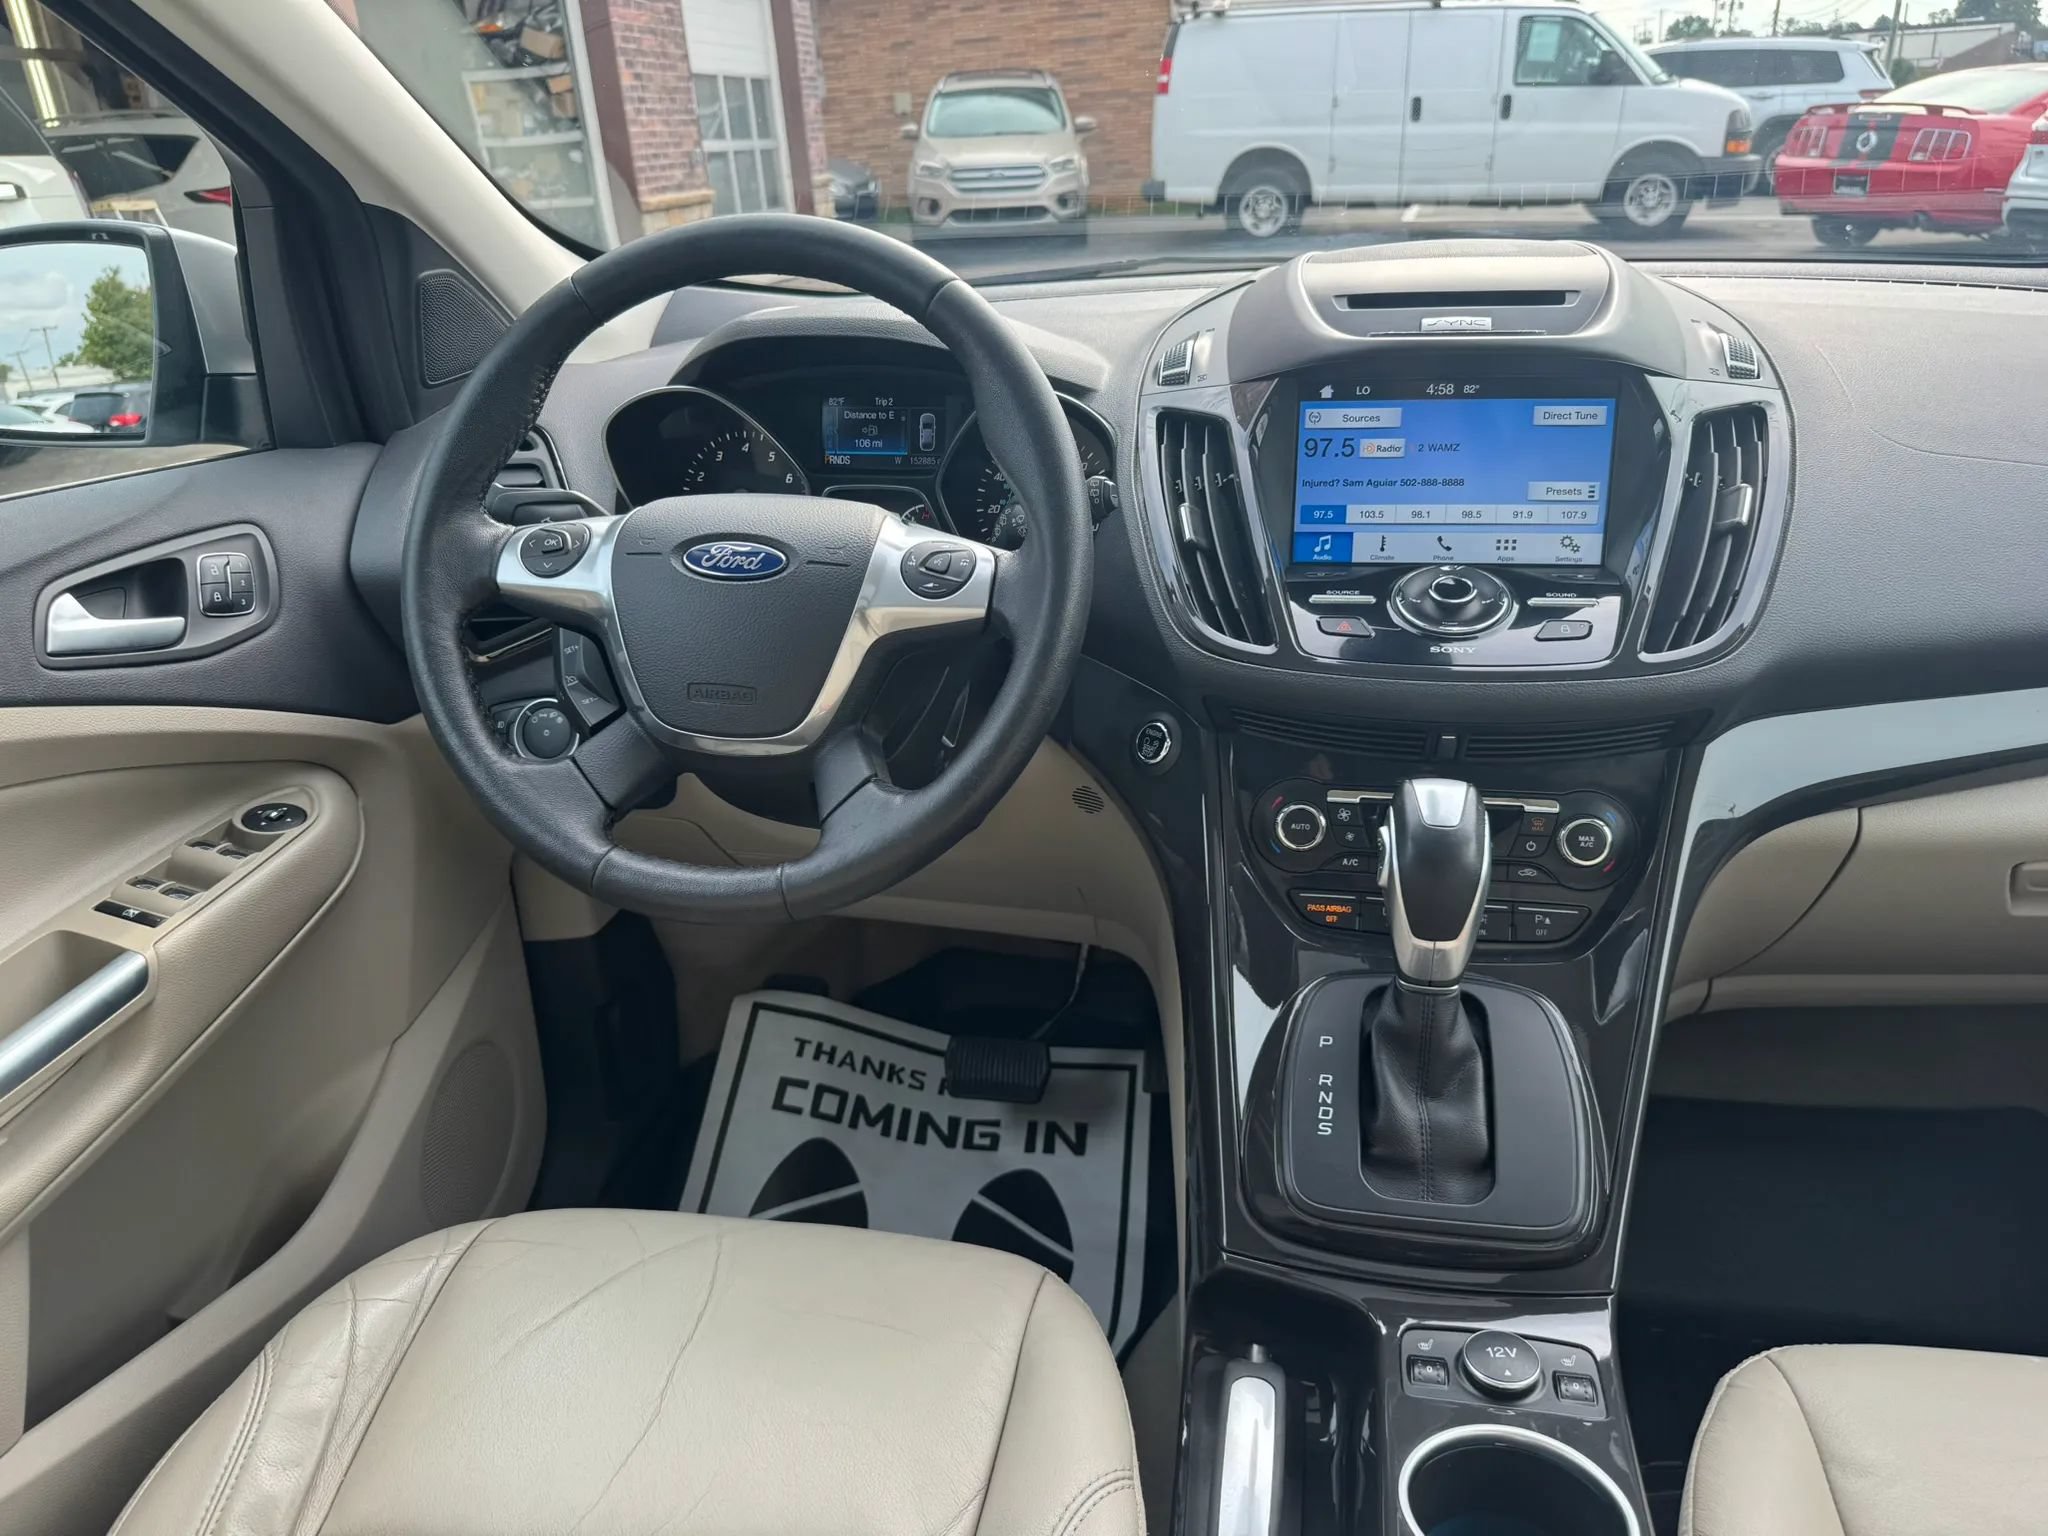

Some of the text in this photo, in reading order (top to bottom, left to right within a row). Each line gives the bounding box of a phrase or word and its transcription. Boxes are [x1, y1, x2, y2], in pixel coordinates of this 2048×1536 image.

[1427, 319, 1487, 327] SYNC
[1356, 386, 1371, 396] LO
[1426, 383, 1455, 395] 4:58
[875, 397, 894, 407] Trip 2
[843, 410, 895, 420] Distance to E
[1342, 413, 1380, 423] Sources
[1543, 411, 1598, 420] Direct Tune
[741, 442, 750, 453] 4
[855, 439, 883, 448] 106 mi
[1304, 438, 1355, 458] 97.5
[1418, 443, 1424, 452] 2
[1428, 442, 1461, 452] WAMZ
[715, 451, 723, 461] 3
[767, 451, 776, 462] 5
[824, 455, 851, 465] PRNDS
[894, 456, 902, 464] W
[697, 472, 705, 482] 2
[785, 473, 793, 484] 6
[1302, 478, 1465, 488] Injured? Sam Aguiar 502-888-8888
[1545, 486, 1582, 496] Presets
[987, 505, 1001, 514] 20
[1313, 510, 1334, 519] 97.5
[1359, 510, 1384, 519] 103.5
[1411, 510, 1431, 519] 98.1
[1461, 510, 1482, 519] 98.5
[1512, 510, 1533, 519] 91.9
[1561, 510, 1587, 519] 107.9
[544, 538, 558, 546] OK
[701, 544, 766, 570] Ford
[1555, 555, 1583, 563] Settings
[1430, 646, 1476, 654] SONY
[1290, 823, 1311, 831] AUTO
[1342, 858, 1359, 866] A/C
[1306, 903, 1352, 913] PASS AIRBAG
[1319, 1035, 1333, 1048] P
[794, 1036, 928, 1091] THANKS
[772, 1076, 1089, 1157] COMING IN
[1485, 1346, 1518, 1359] 12V
